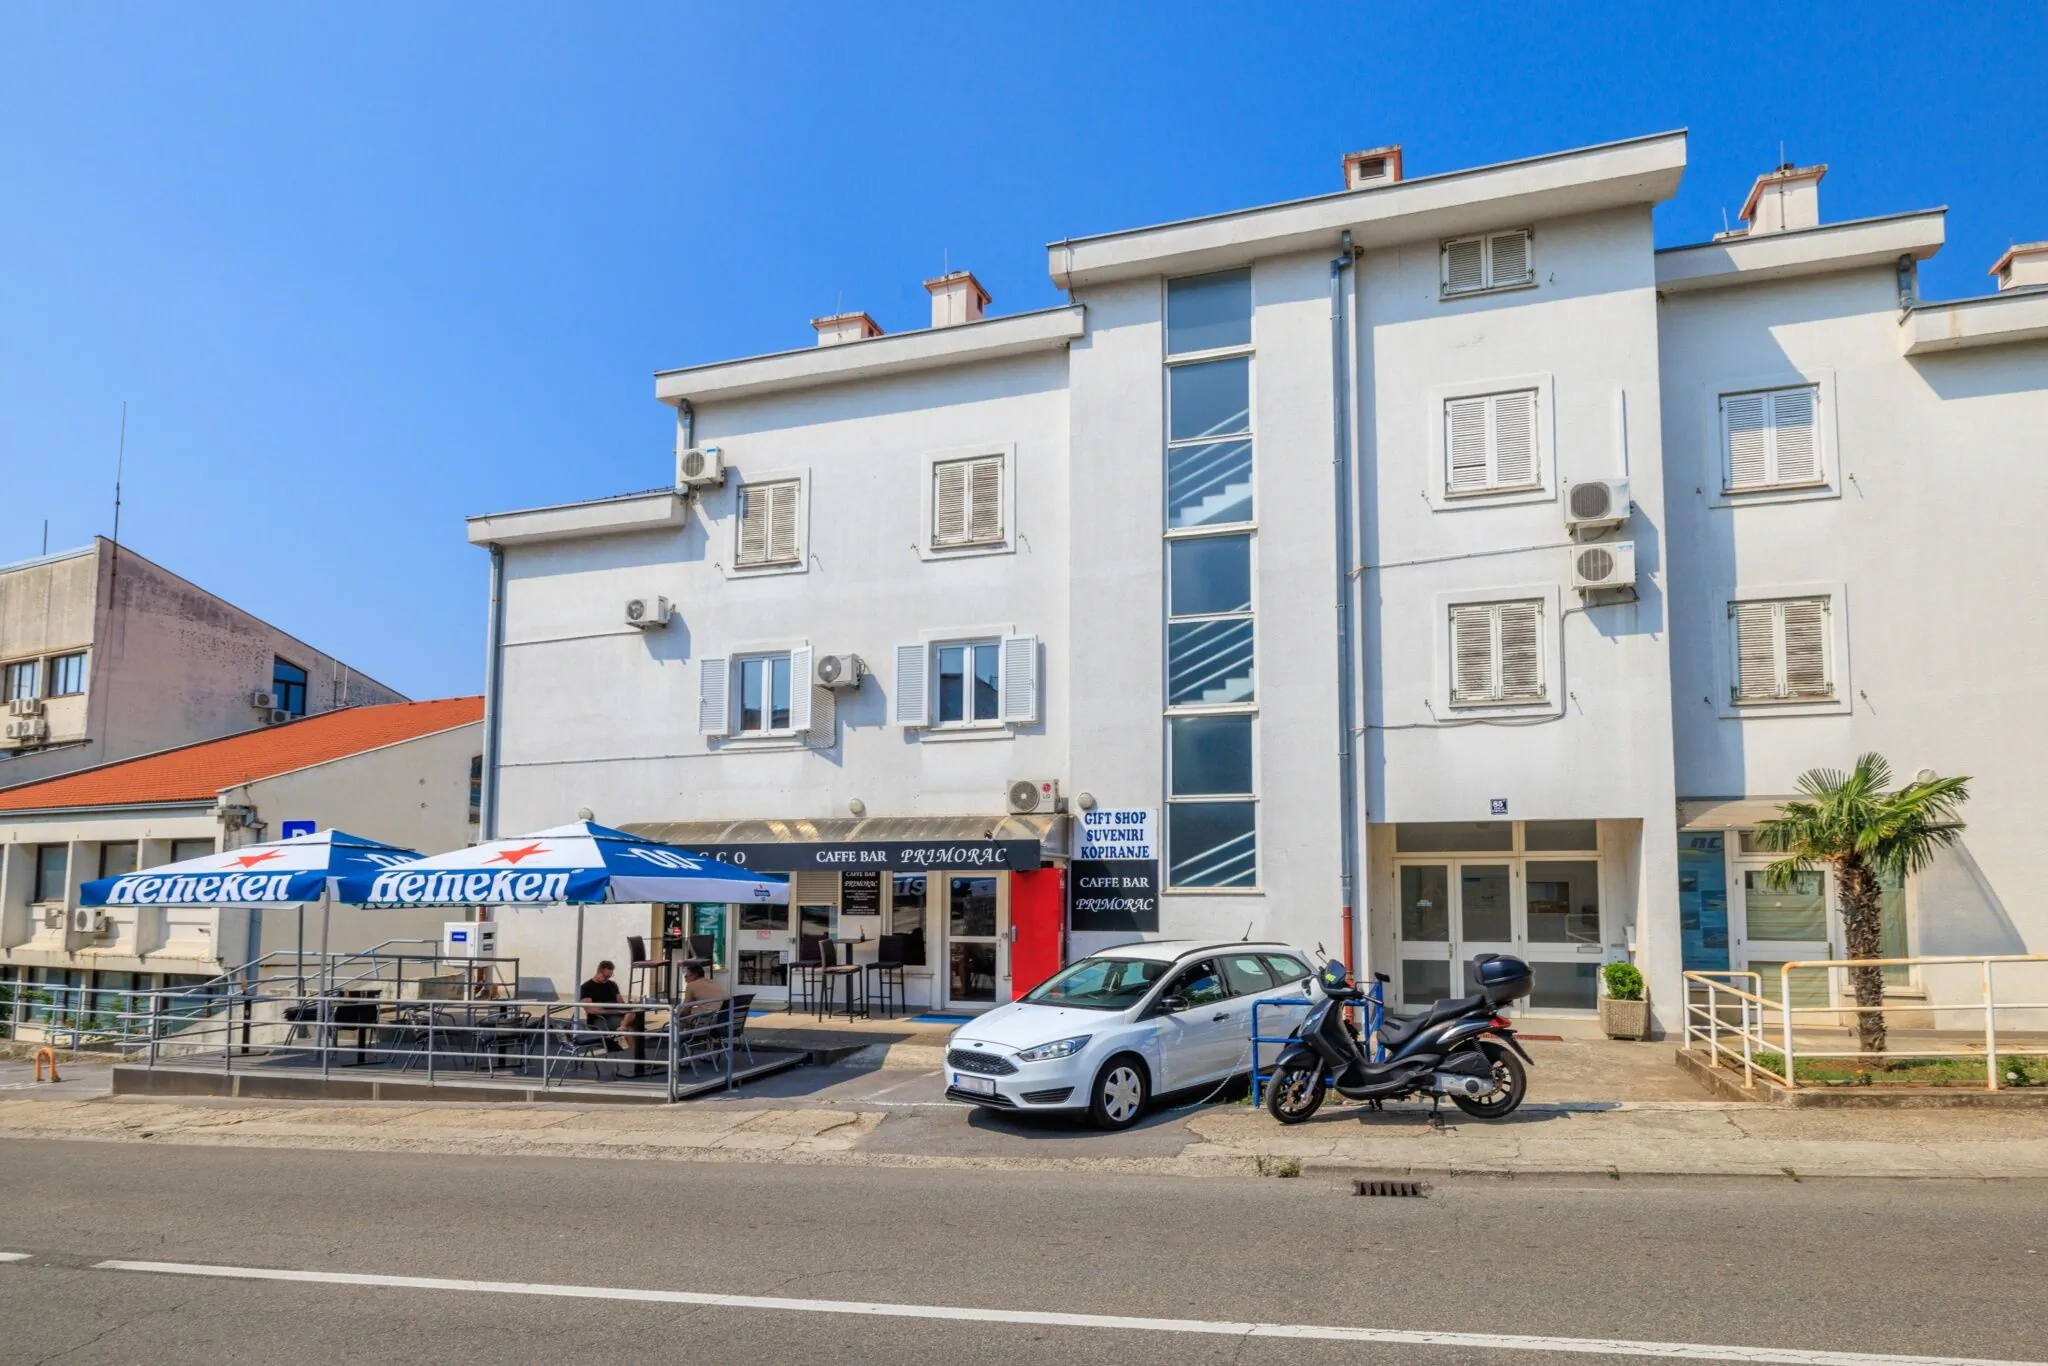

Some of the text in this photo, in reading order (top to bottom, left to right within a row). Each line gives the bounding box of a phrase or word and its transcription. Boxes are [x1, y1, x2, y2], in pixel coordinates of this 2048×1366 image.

[1085, 811, 1147, 824] GIFT SHOP
[1086, 829, 1144, 841] SUVENIRI
[816, 847, 1007, 866] CAFFE BAR PRIMORAC
[1081, 846, 1150, 858] KOPIRANJE
[105, 872, 293, 904] Heineken
[367, 869, 569, 902] Heineken
[844, 880, 878, 888] PRIMORAC
[1080, 876, 1150, 888] CAFFE BAR
[1076, 897, 1154, 912] PRIMORAC
